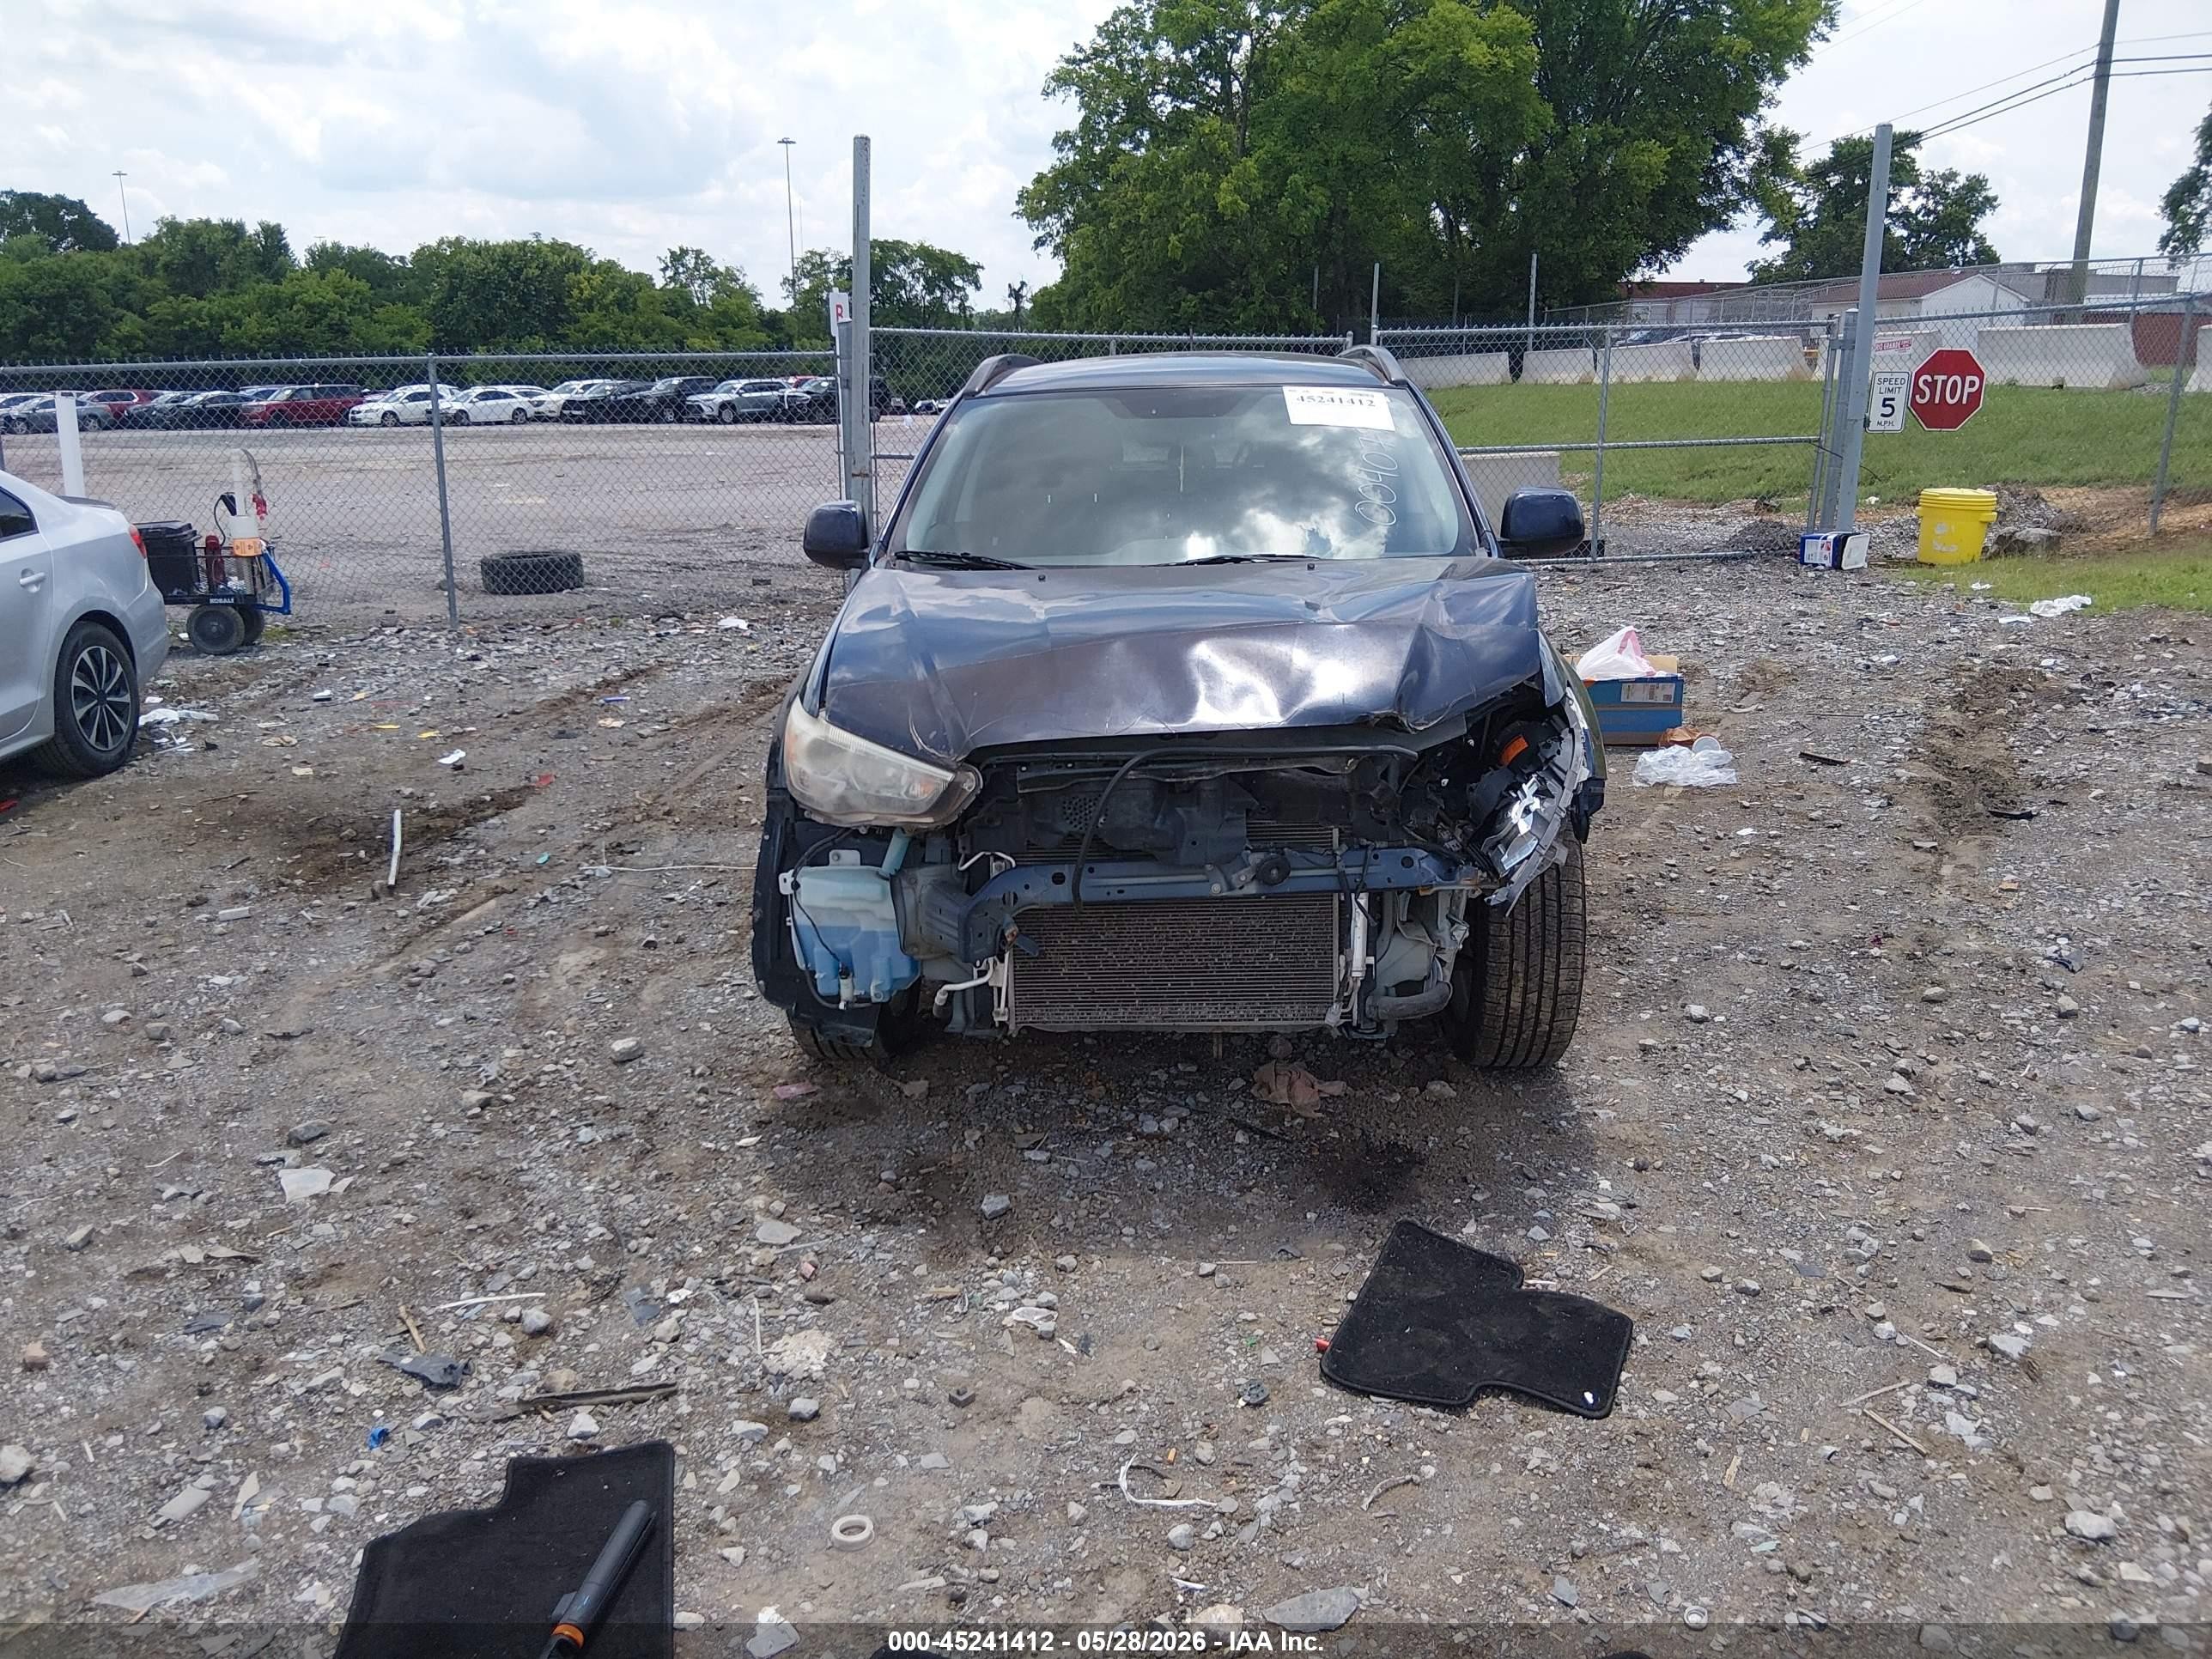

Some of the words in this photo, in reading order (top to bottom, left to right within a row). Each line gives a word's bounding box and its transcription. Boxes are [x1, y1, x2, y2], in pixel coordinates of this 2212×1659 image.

[1876, 377, 1906, 386] SPEED
[1878, 386, 1903, 395] LIMIT
[1915, 374, 1980, 405] STOP
[1297, 395, 1376, 408] 45241412
[1881, 397, 1896, 418] 5
